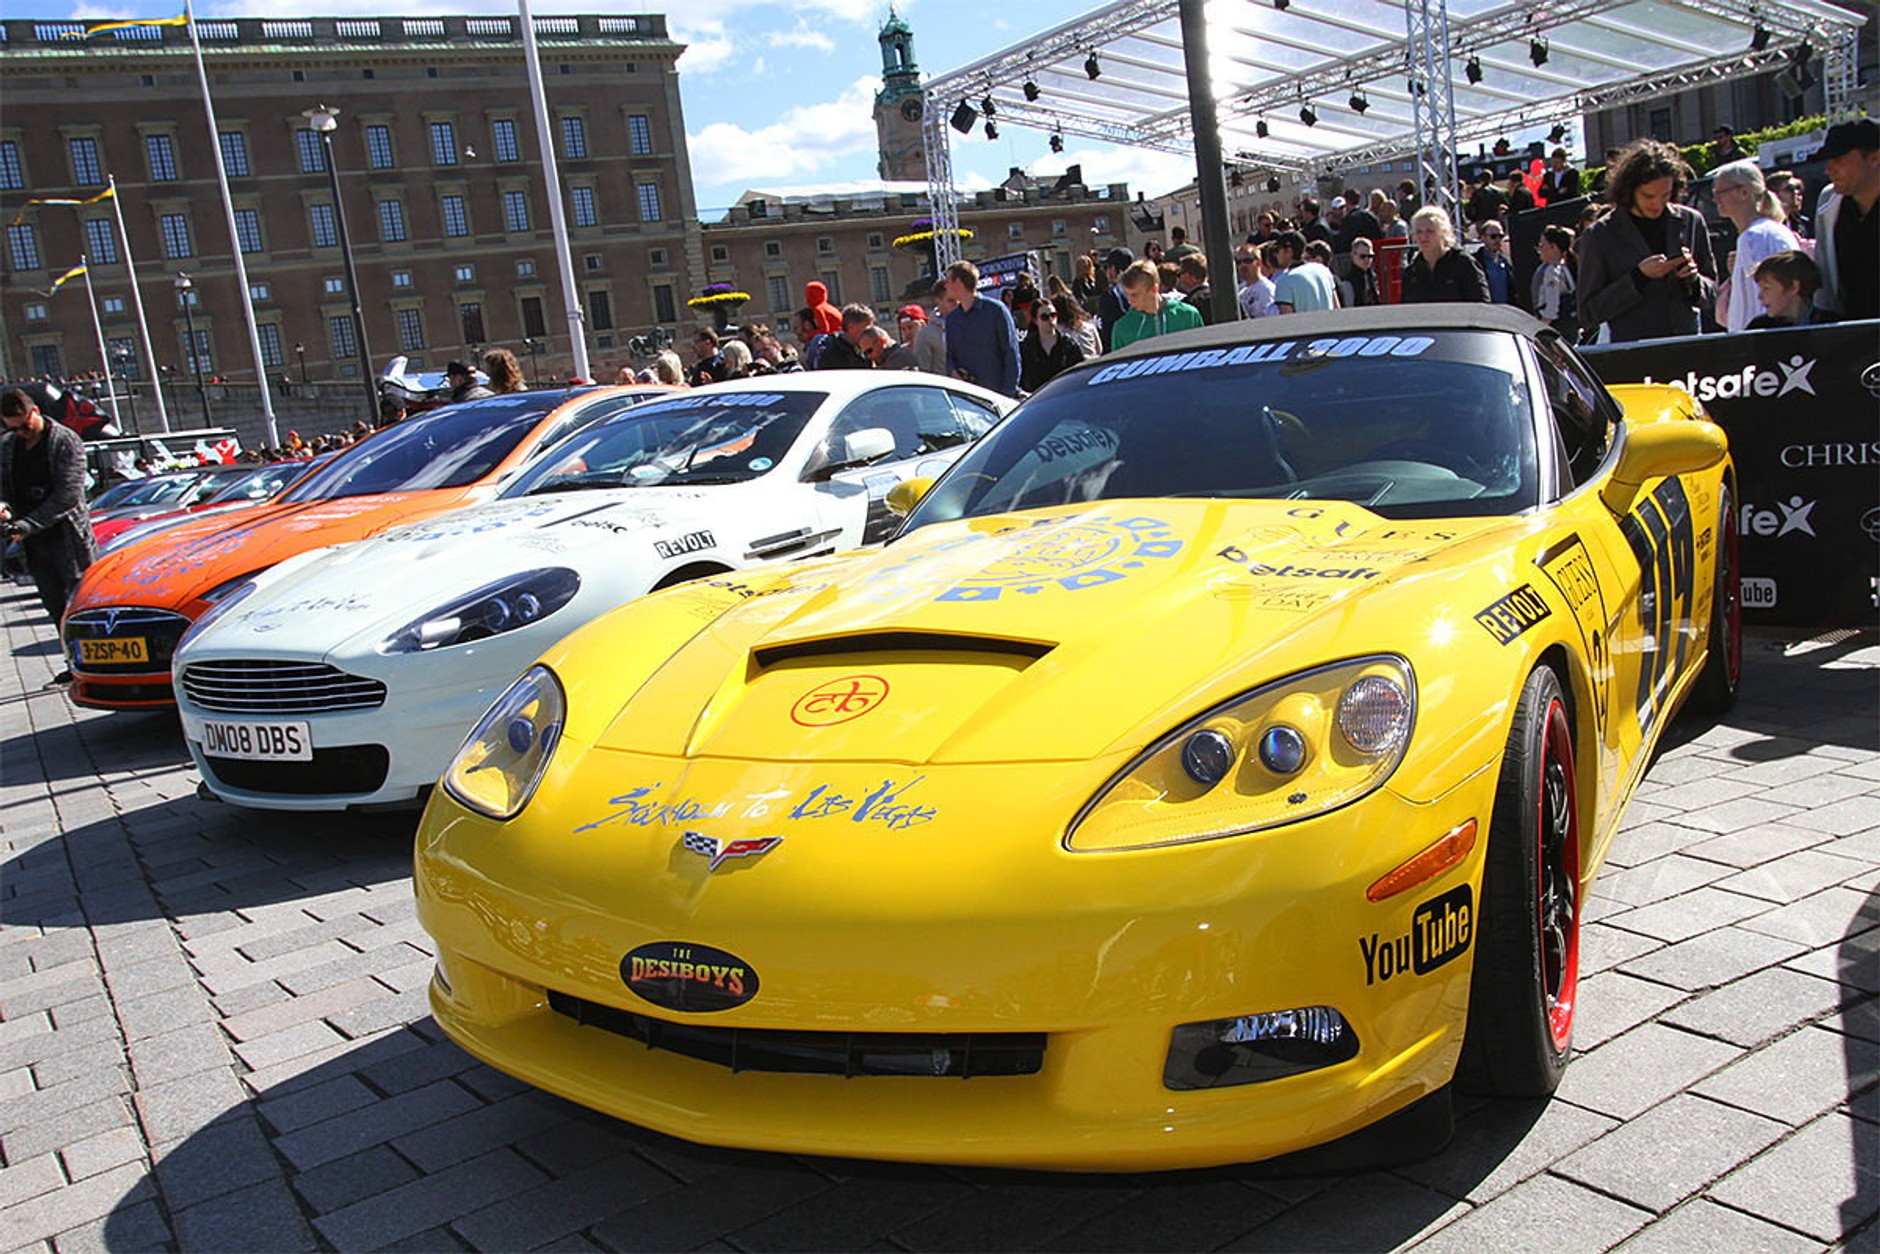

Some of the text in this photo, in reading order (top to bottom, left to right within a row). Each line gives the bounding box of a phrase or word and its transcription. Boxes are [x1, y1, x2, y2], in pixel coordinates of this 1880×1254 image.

[1088, 337, 1436, 386] GUMBALL 3000
[1644, 365, 1779, 401] tsafe
[656, 530, 715, 558] REVOLT
[1741, 580, 1773, 603] ube
[1478, 586, 1549, 642] REVOLT
[82, 641, 142, 660] 3-ZSP-40
[204, 723, 301, 754] DM08 DBS
[1359, 902, 1470, 986] YouTube
[630, 957, 744, 996] DESIBOYS
